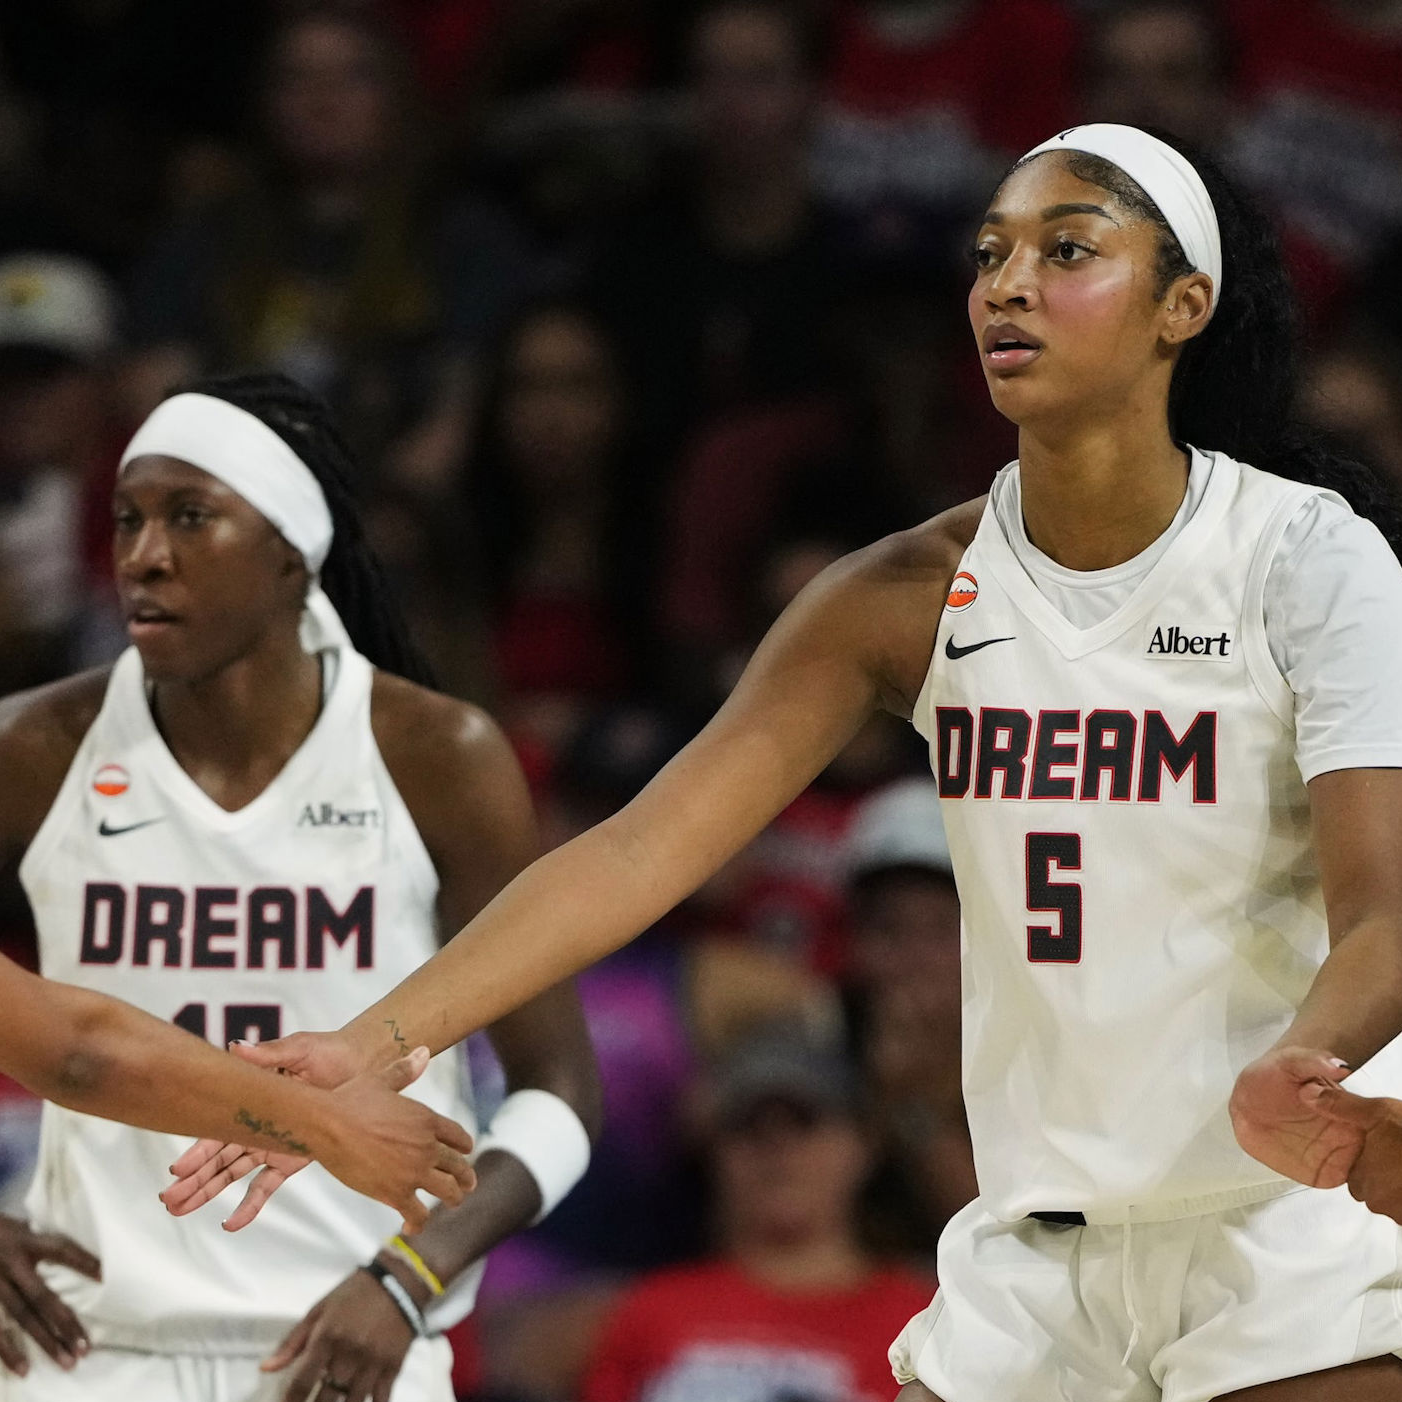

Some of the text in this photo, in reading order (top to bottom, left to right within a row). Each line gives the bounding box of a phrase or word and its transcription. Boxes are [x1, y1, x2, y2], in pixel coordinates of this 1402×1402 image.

[1147, 626, 1231, 657] Albert
[935, 705, 1218, 804] DREAM
[297, 803, 381, 829] Albert
[79, 882, 376, 970] DREAM
[1025, 831, 1083, 964] 5
